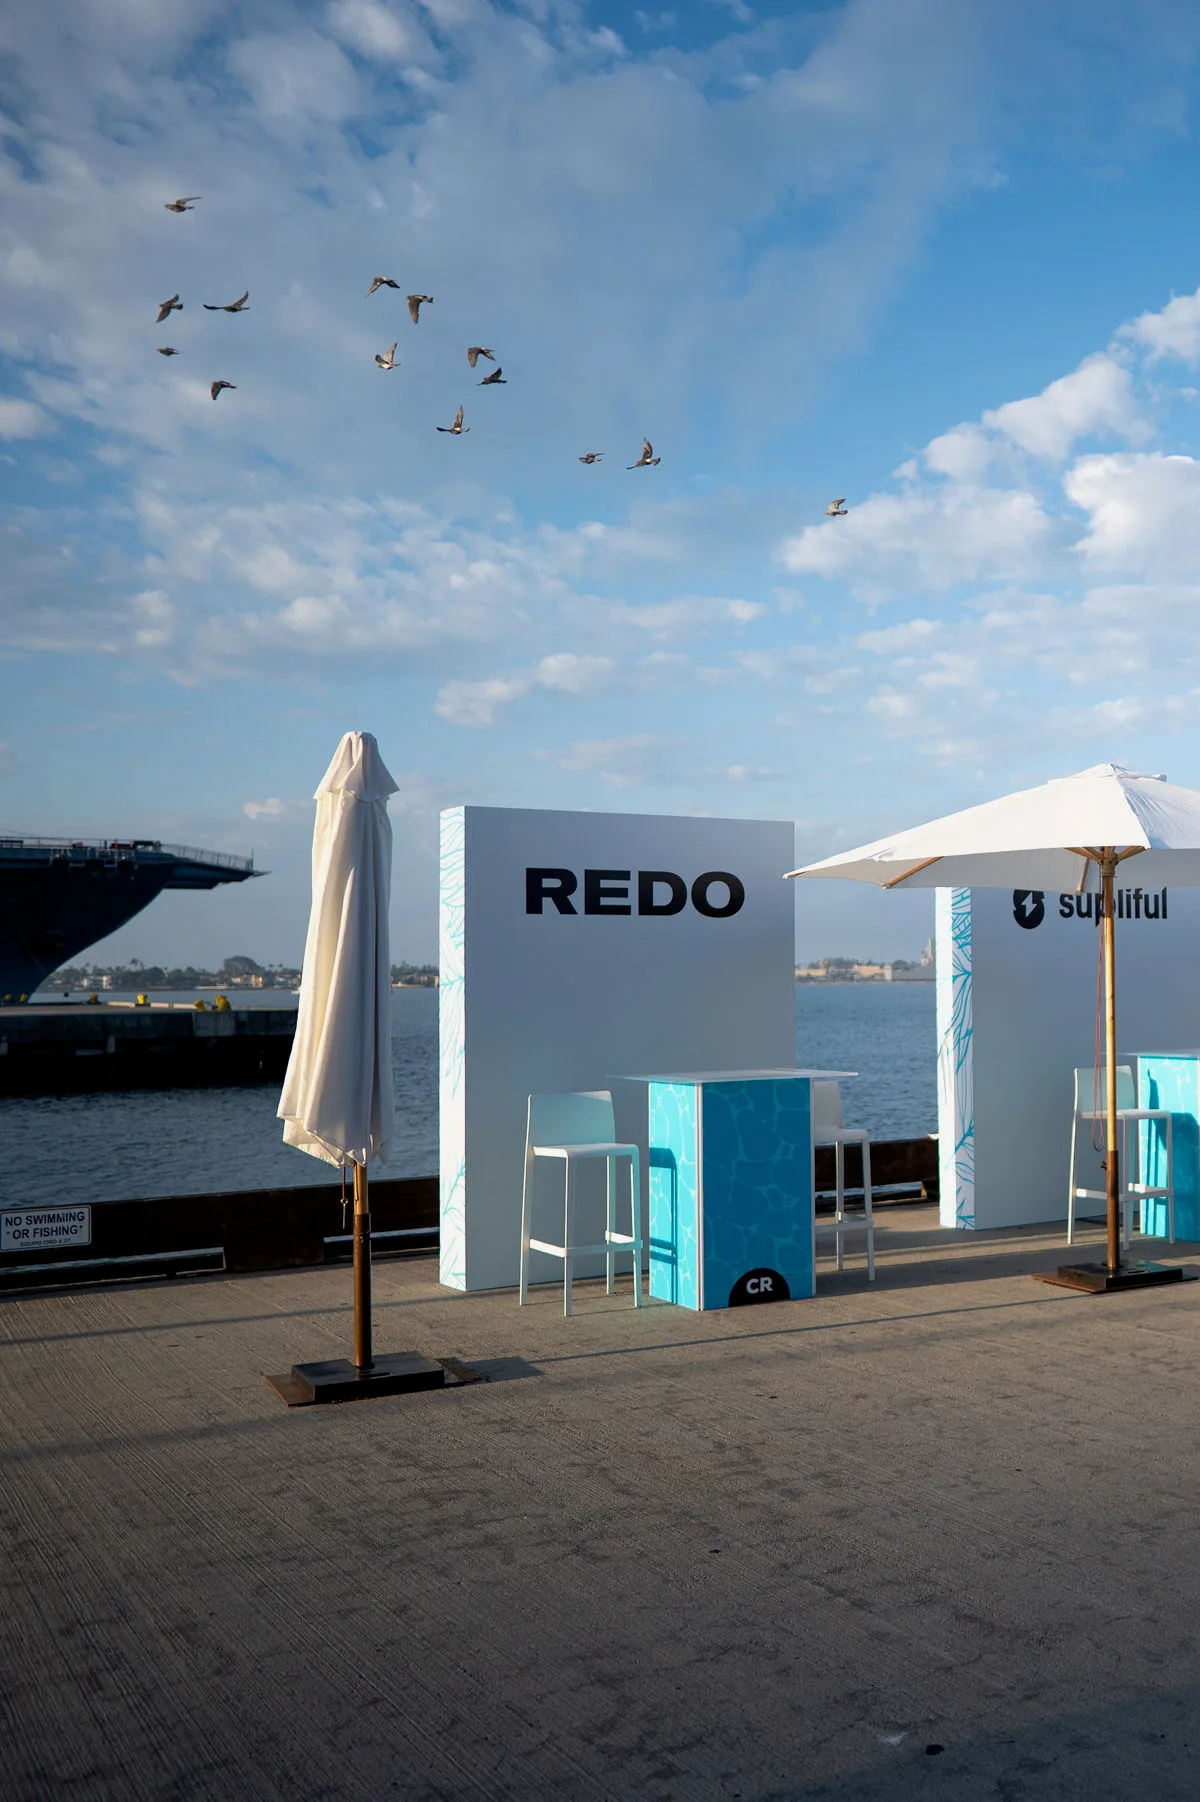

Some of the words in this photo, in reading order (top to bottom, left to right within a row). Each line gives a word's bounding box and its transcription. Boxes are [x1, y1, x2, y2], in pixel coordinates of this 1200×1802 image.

[526, 867, 745, 918] REDO
[5, 1216, 22, 1227] NO
[25, 1211, 85, 1225] SWIMMING
[13, 1229, 30, 1240] OR
[33, 1225, 78, 1238] FISHING
[746, 1276, 773, 1294] CR
